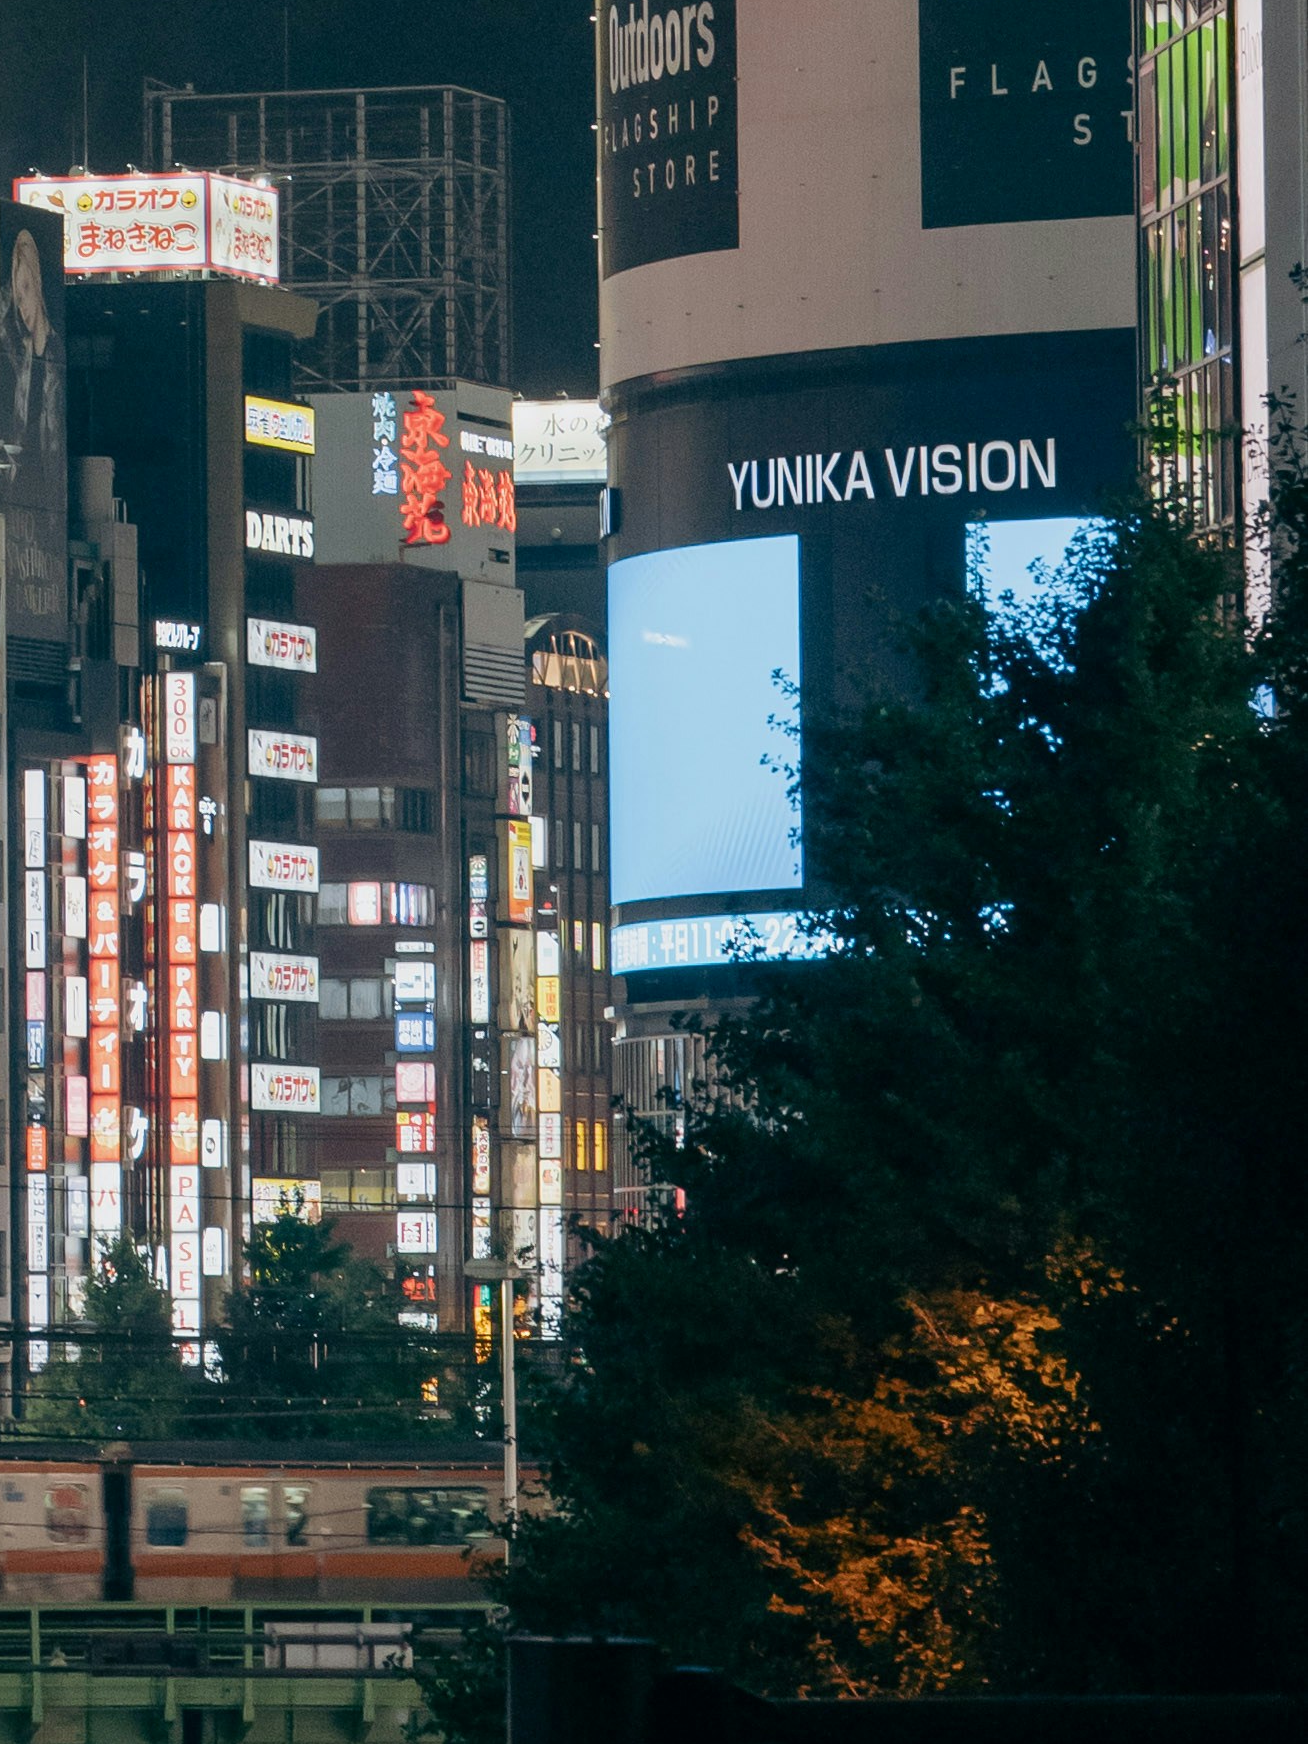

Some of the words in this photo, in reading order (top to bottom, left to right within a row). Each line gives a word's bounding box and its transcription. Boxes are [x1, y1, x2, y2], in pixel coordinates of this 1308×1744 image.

[603, 94, 721, 156] FLAGSHIP
[632, 150, 721, 199] STORE
[93, 188, 181, 213] カラオケ
[237, 194, 269, 221] カラオケ
[77, 220, 199, 259] まねきねこ
[232, 225, 273, 265] まねきねこ
[398, 389, 452, 546] 東海苑
[728, 450, 874, 513] YUNIKA
[883, 437, 1058, 499] VISION
[461, 460, 516, 533] 東海苑
[245, 510, 315, 558] DARTS
[270, 631, 307, 662] カラオケ
[272, 742, 308, 772] カラオケ
[173, 765, 192, 922] KARAOKE
[273, 852, 309, 883] カラオケ
[174, 935, 192, 954] &
[273, 964, 309, 992] カラオケ
[175, 965, 193, 1078] PARTY
[274, 1074, 310, 1103] カラオケ
